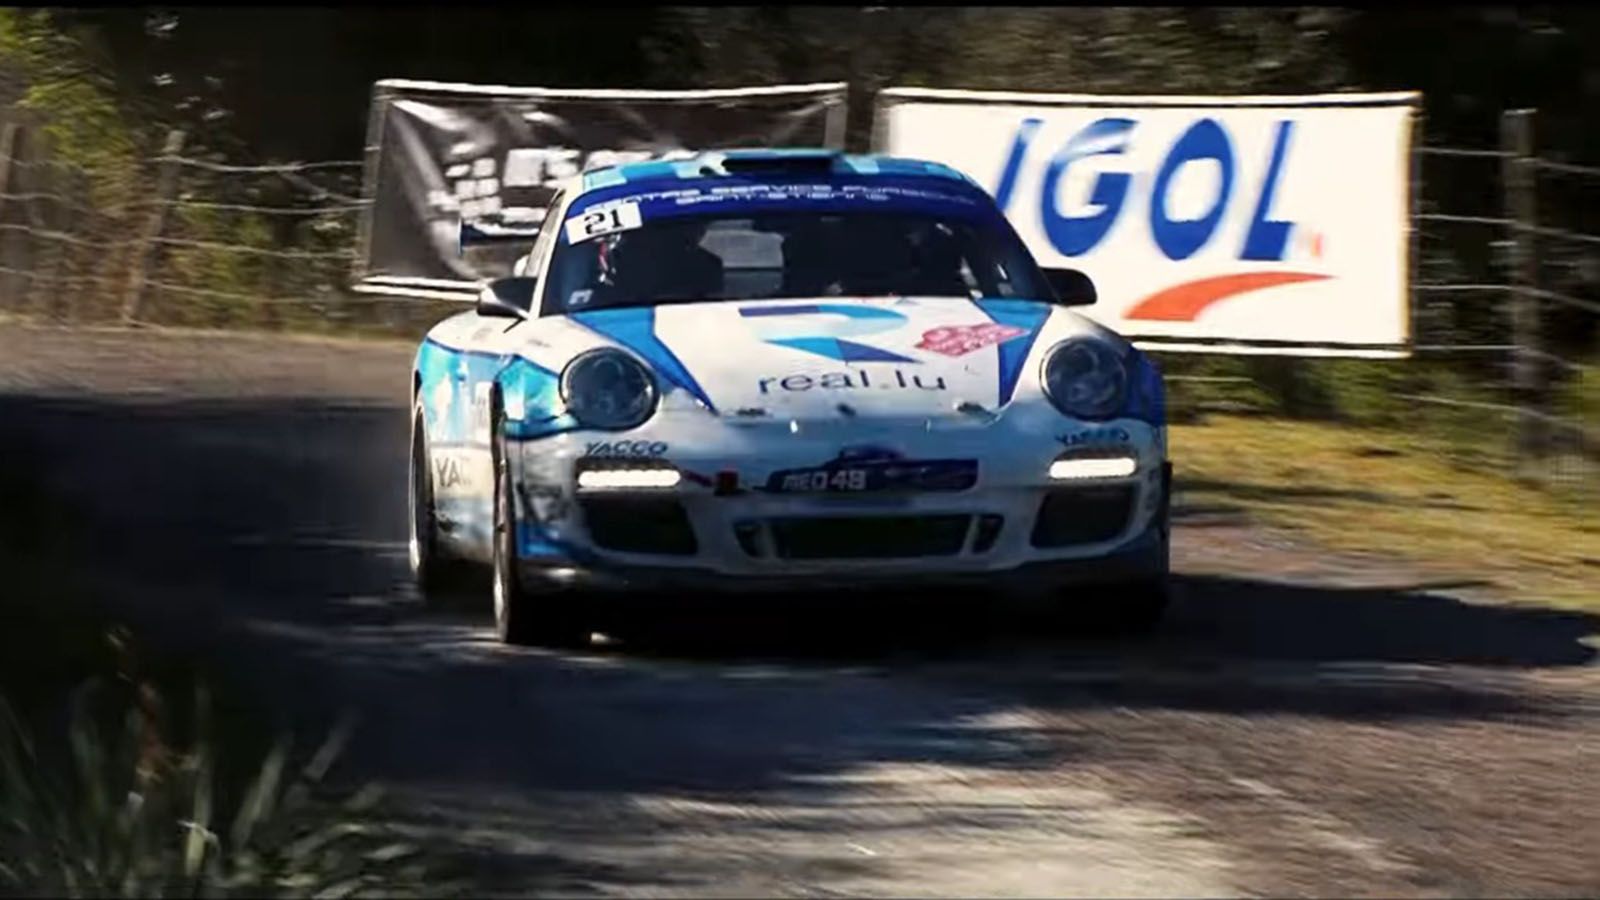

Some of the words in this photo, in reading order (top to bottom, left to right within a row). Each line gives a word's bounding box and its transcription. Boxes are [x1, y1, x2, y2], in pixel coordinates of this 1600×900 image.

[994, 116, 1298, 262] IGOL
[583, 208, 624, 236] 21
[756, 369, 947, 394] real.lu
[585, 440, 668, 457] YACCO
